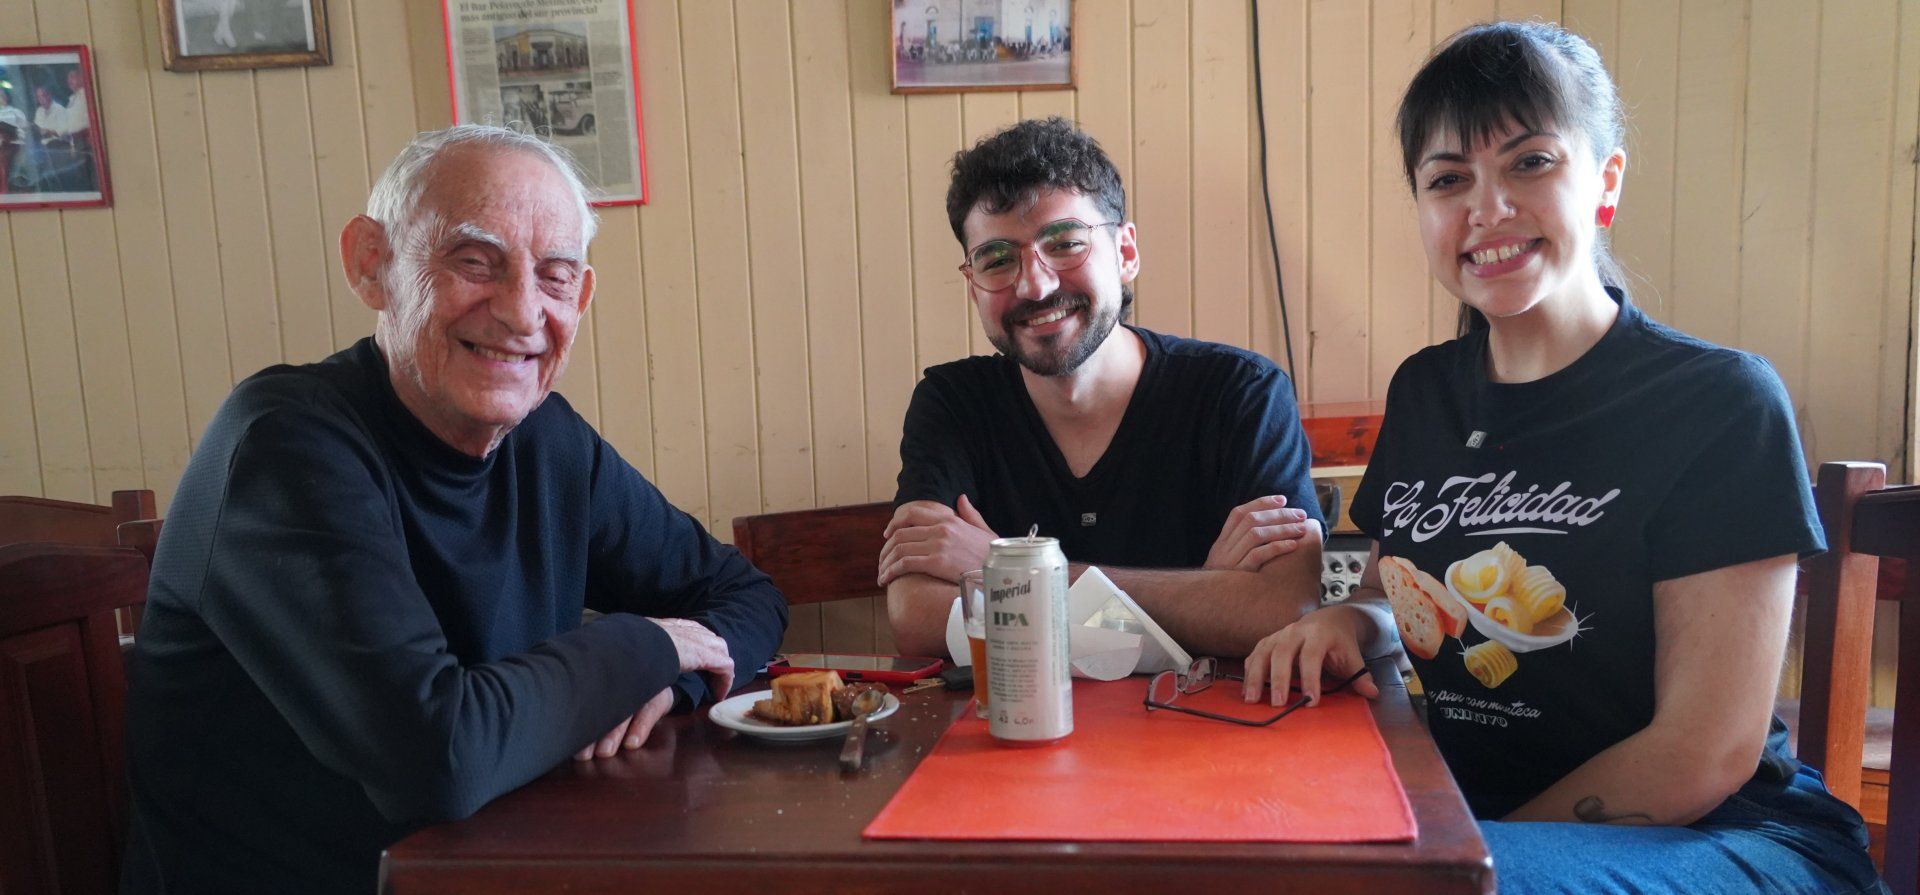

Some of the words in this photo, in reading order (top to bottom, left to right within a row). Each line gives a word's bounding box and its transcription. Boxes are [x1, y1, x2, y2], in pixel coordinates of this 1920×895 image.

[551, 5, 598, 18] provincial
[1382, 480, 1425, 537] La
[1411, 470, 1621, 543] Felicidad
[990, 579, 1031, 604] Imperial
[993, 611, 1029, 627] IPA
[1435, 689, 1465, 703] pan
